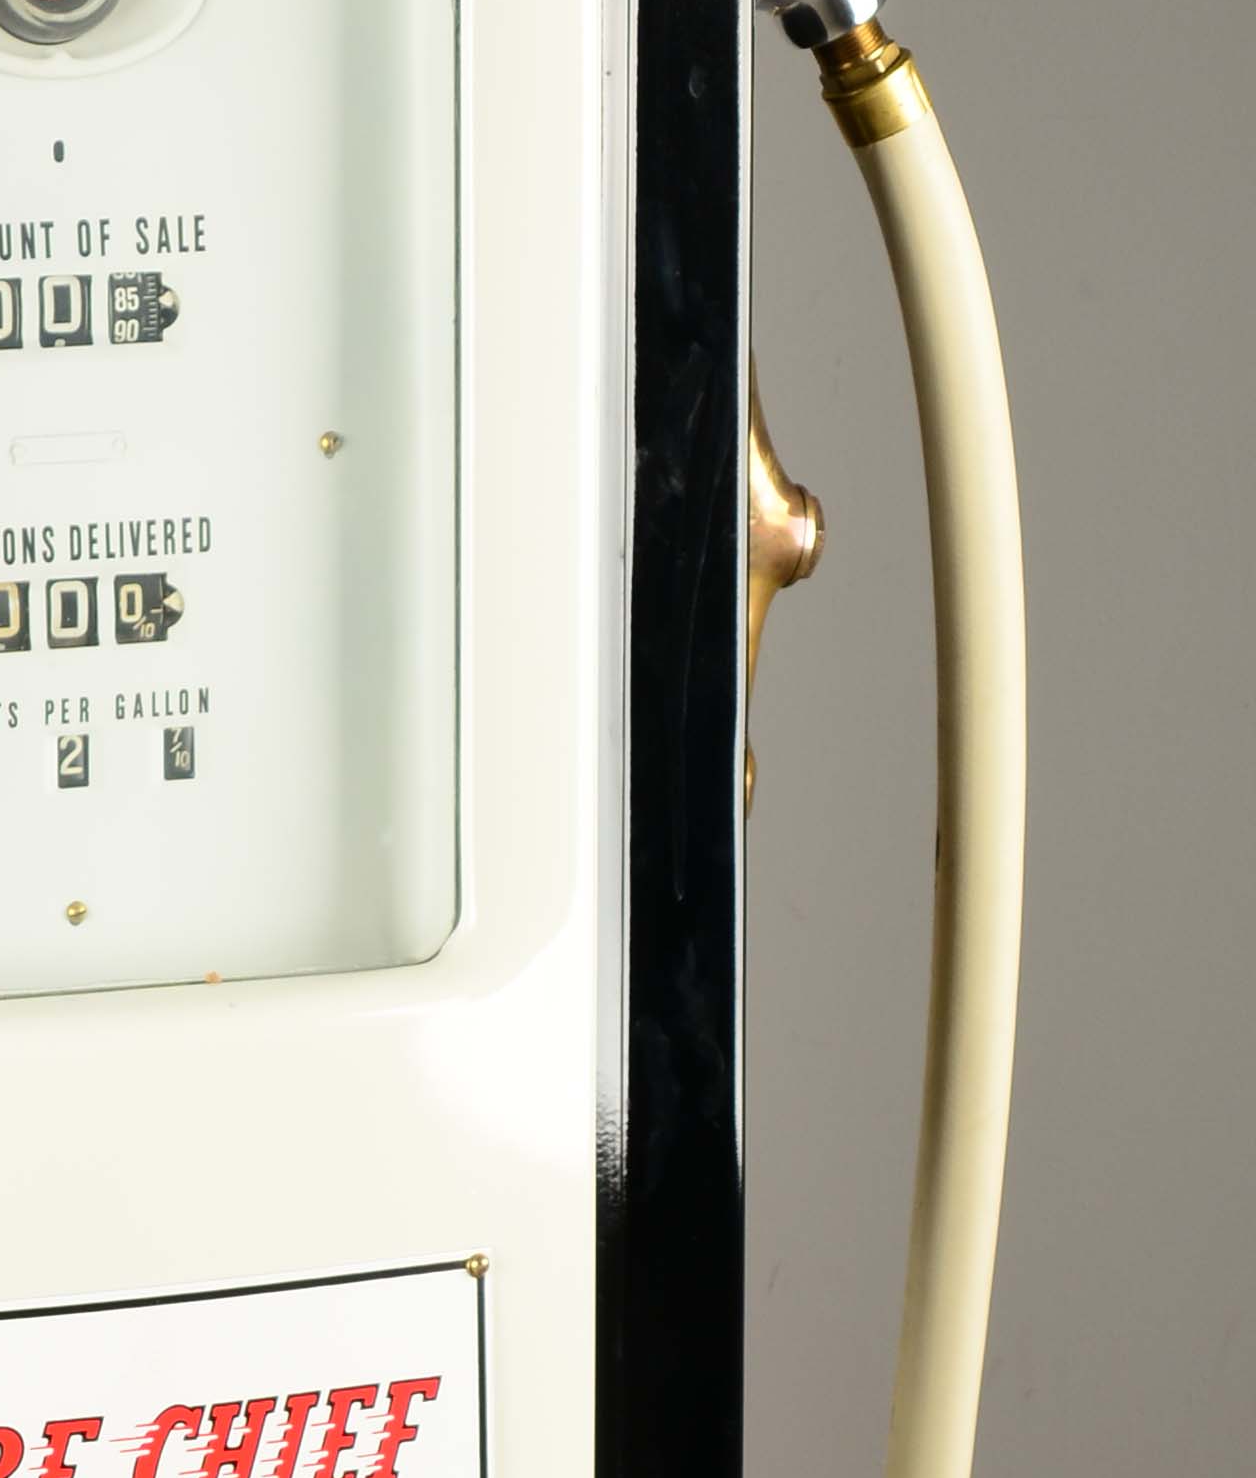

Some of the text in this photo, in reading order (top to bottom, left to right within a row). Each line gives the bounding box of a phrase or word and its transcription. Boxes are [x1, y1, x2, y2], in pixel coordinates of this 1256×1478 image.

[77, 218, 111, 258] OF
[135, 214, 207, 255] SALE
[114, 286, 140, 313] 85
[68, 516, 212, 562] DELIVERED
[45, 696, 90, 725] PER
[114, 686, 210, 720] GALLON
[59, 735, 84, 776] 2
